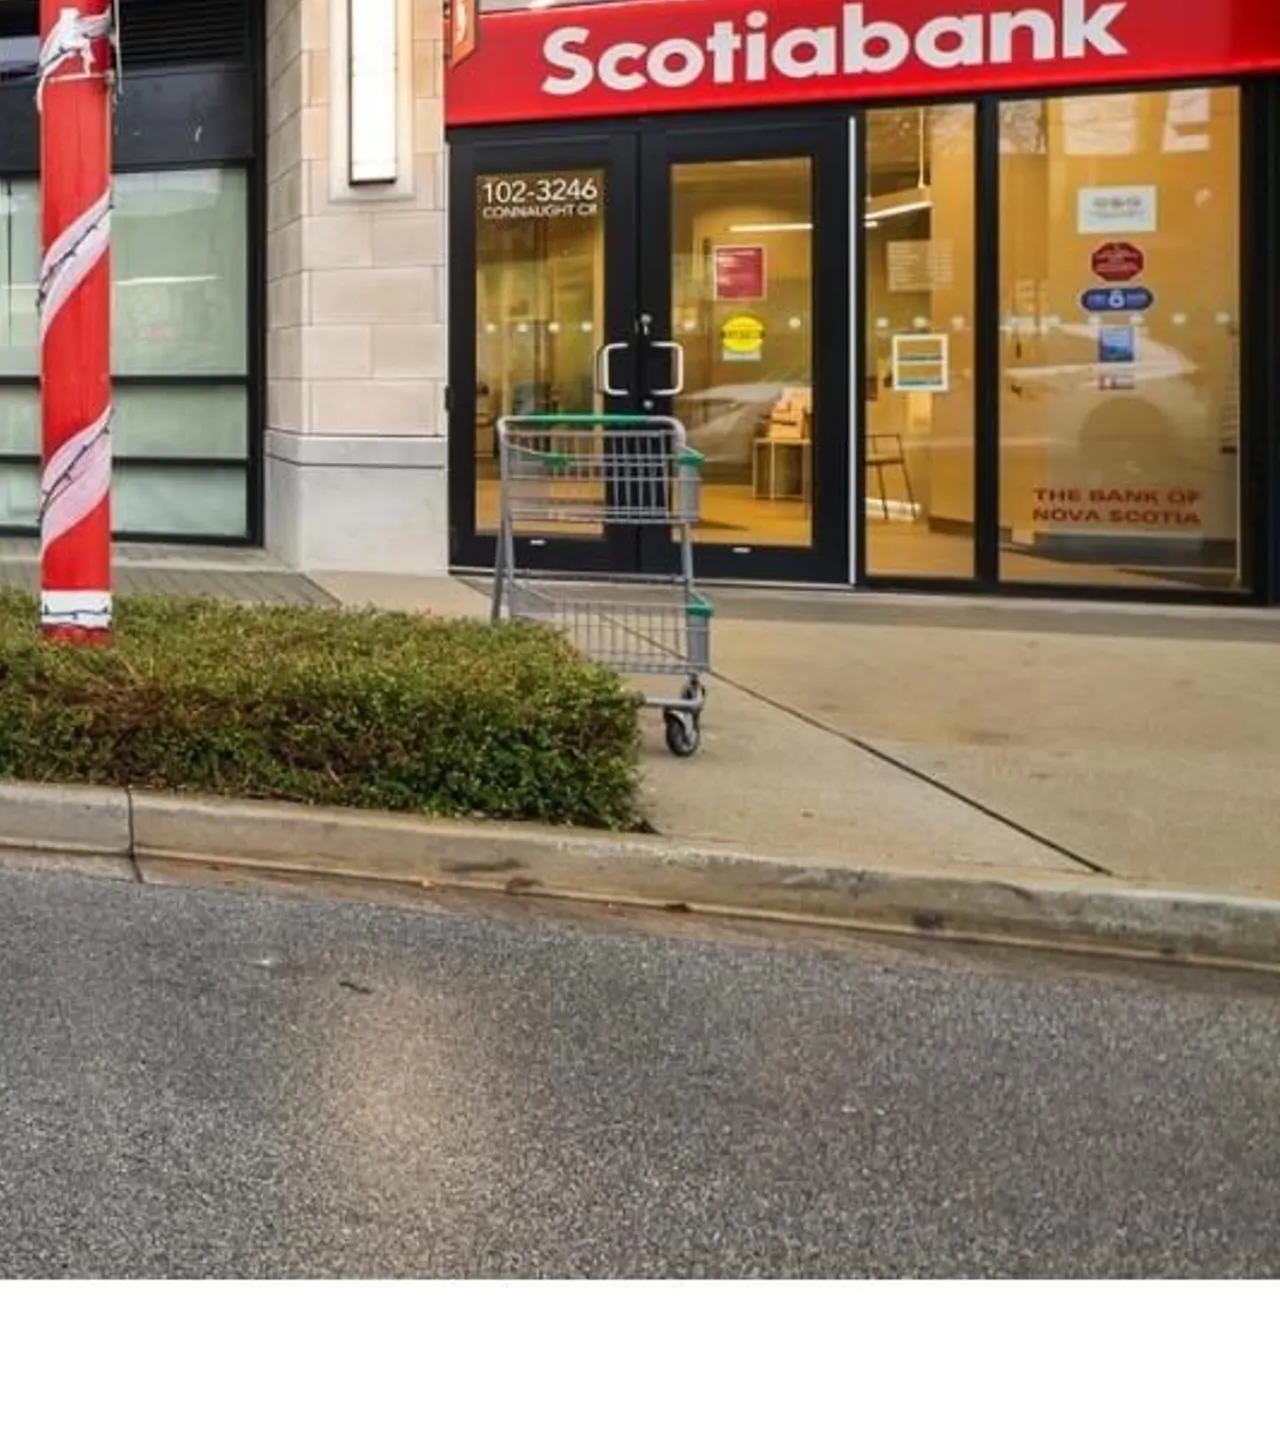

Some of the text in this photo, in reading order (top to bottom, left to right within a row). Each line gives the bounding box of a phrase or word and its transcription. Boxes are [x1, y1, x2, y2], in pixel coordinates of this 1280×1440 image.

[481, 177, 598, 203] 102-3246
[482, 203, 575, 220] CONNAUGHT
[1033, 487, 1204, 505] THE BANK OF
[1032, 508, 1202, 525] NOVA SCOTIA
